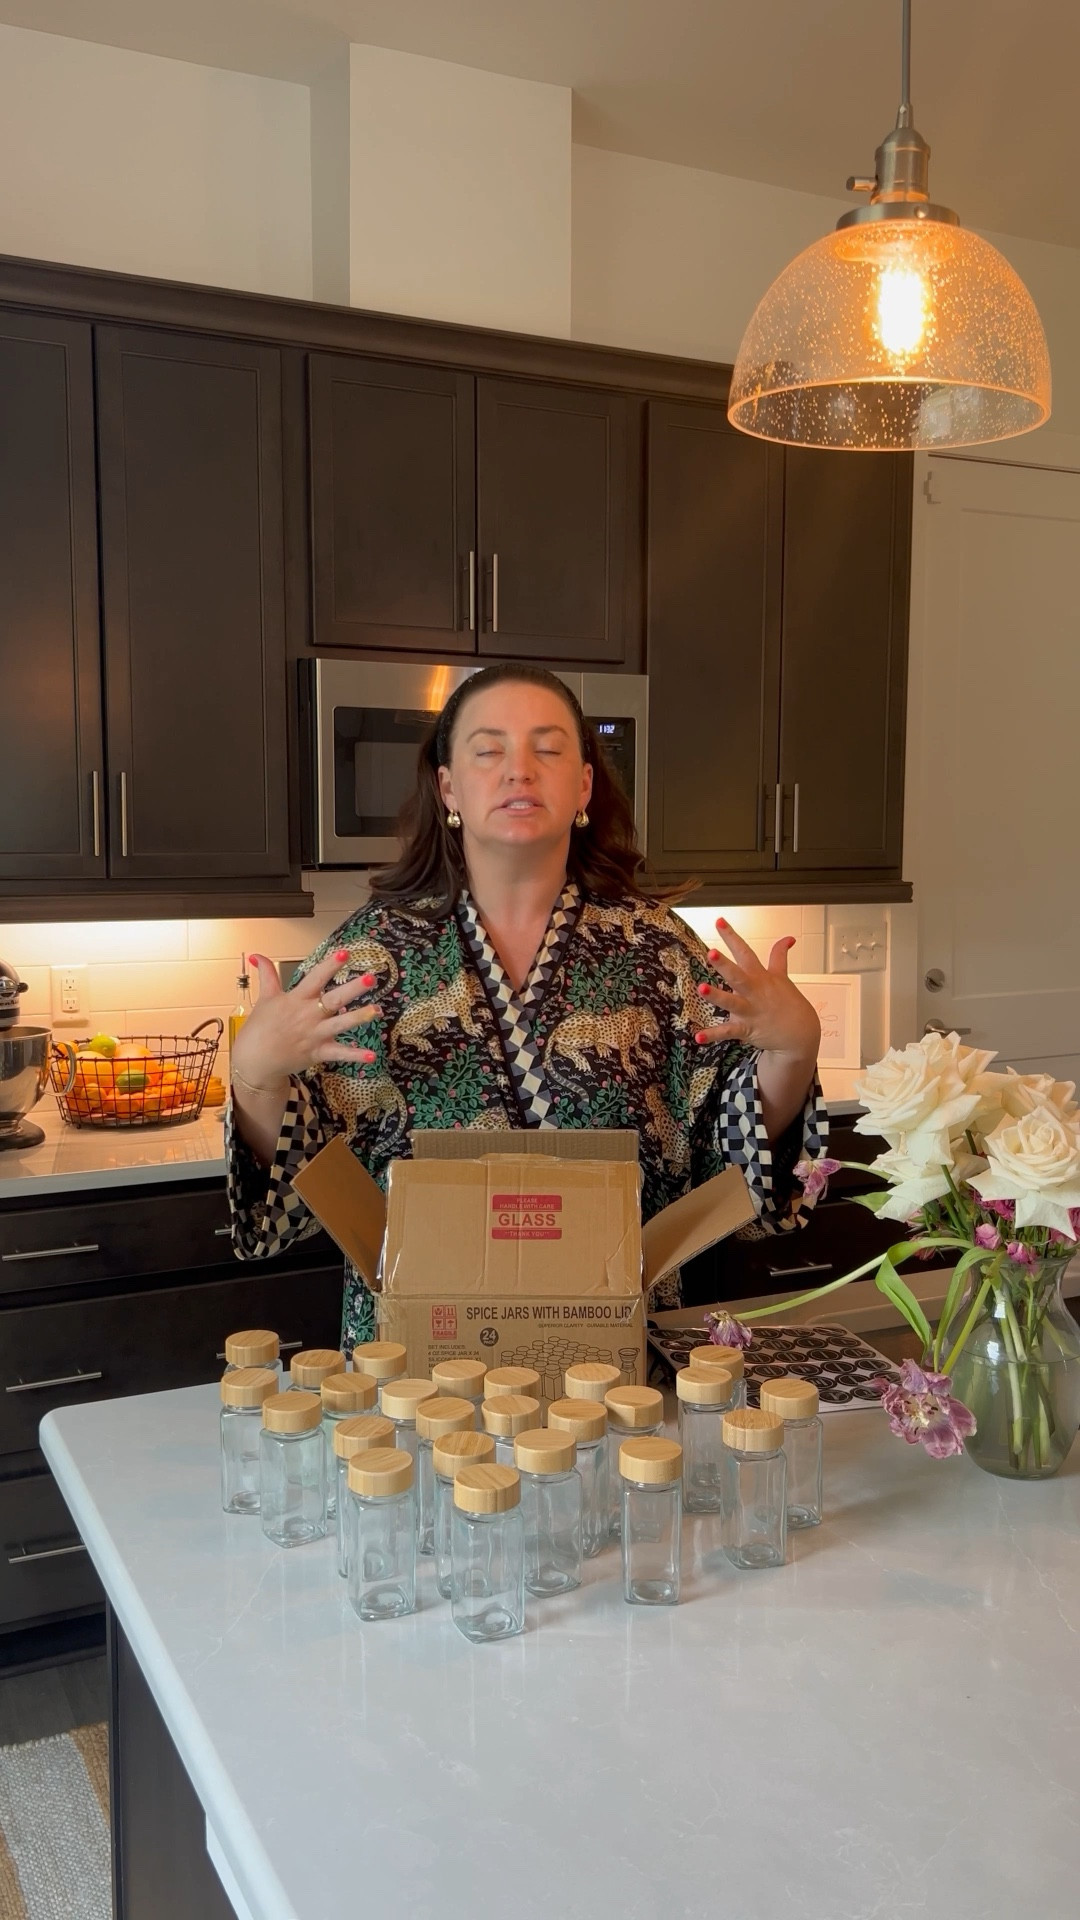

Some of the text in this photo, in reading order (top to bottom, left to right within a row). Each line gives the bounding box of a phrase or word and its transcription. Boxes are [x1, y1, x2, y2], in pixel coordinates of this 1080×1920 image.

[498, 1213, 556, 1227] GLASS
[466, 1306, 498, 1320] SPICE
[501, 1306, 530, 1320] JARS
[532, 1306, 560, 1319] WITH
[563, 1306, 612, 1319] BAMBOO
[482, 1330, 497, 1341] 24
